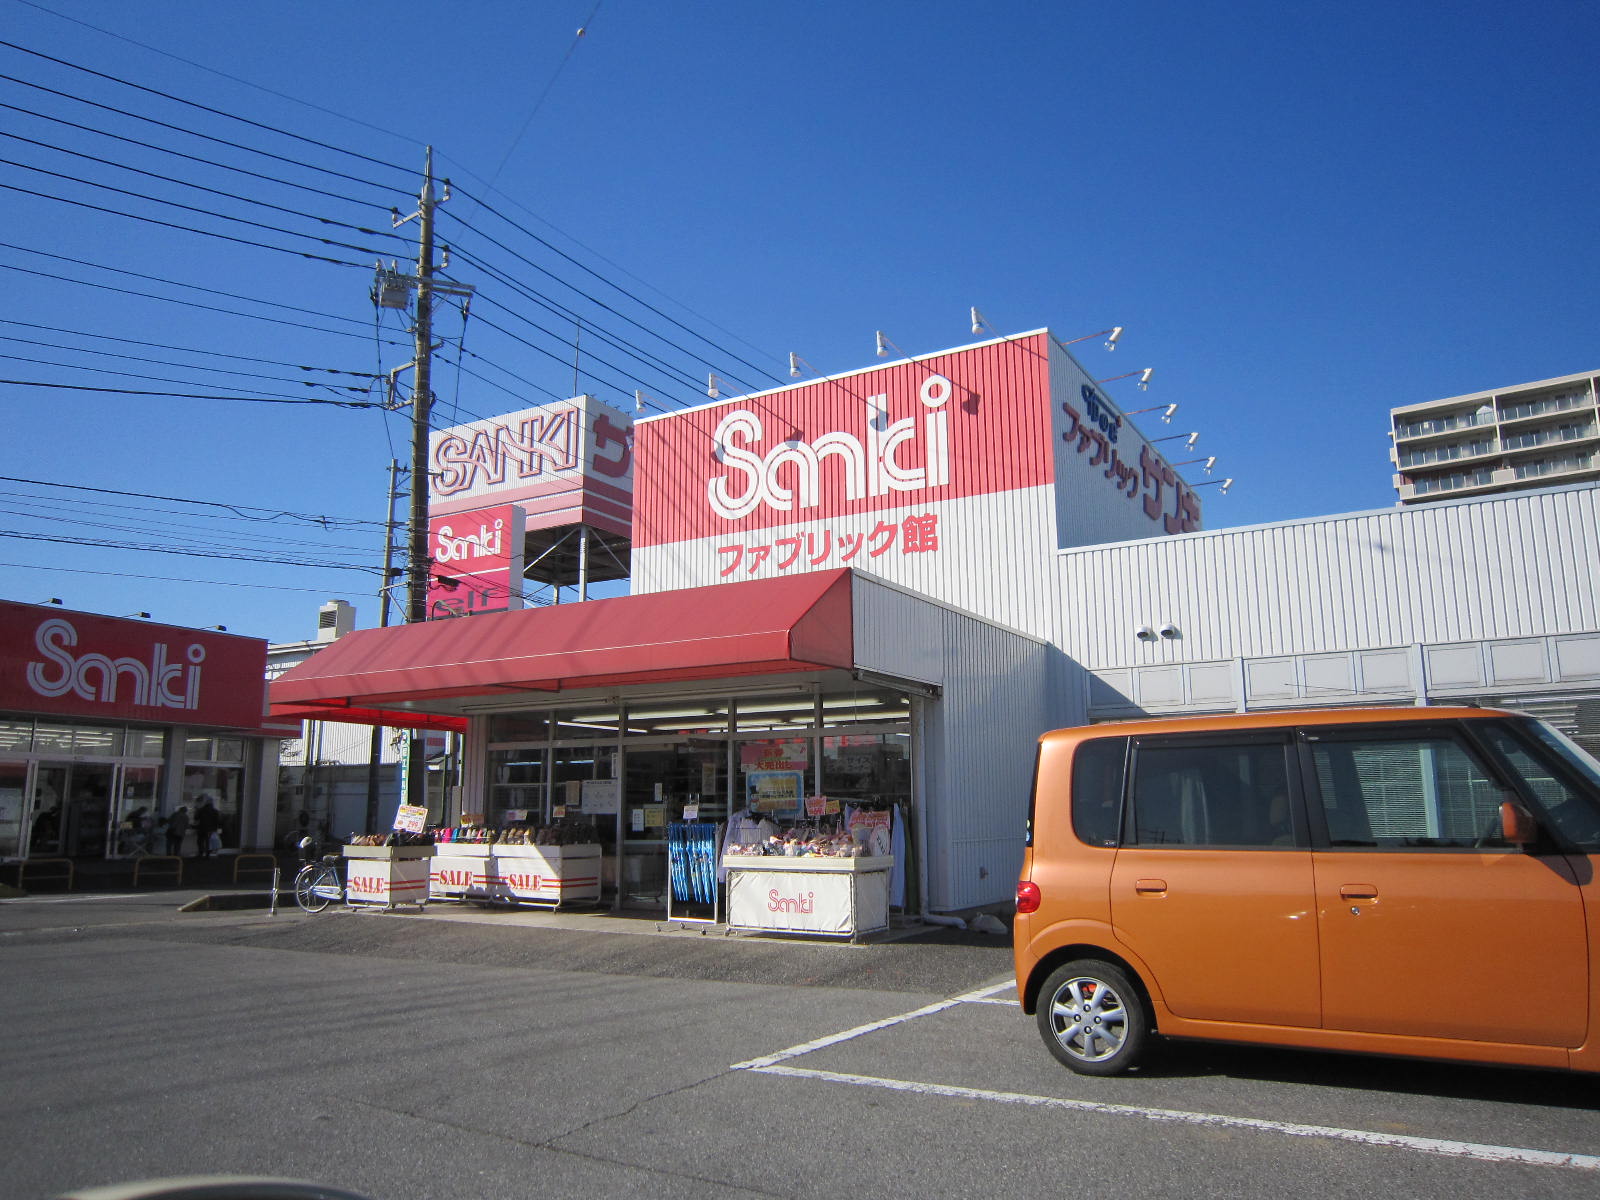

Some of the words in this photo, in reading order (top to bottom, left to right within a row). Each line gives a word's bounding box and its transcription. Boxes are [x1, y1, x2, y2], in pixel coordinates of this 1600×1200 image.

[430, 407, 579, 496] SANKI
[707, 374, 952, 520] Sanki
[1062, 402, 1139, 498] ファブリック
[435, 518, 504, 563] Sanki
[717, 513, 938, 577] ファブリック館
[26, 618, 206, 711] Sanki
[352, 876, 385, 894] SALE
[439, 869, 473, 887] SALE
[508, 873, 542, 891] SALE
[767, 888, 814, 914] Sanki
